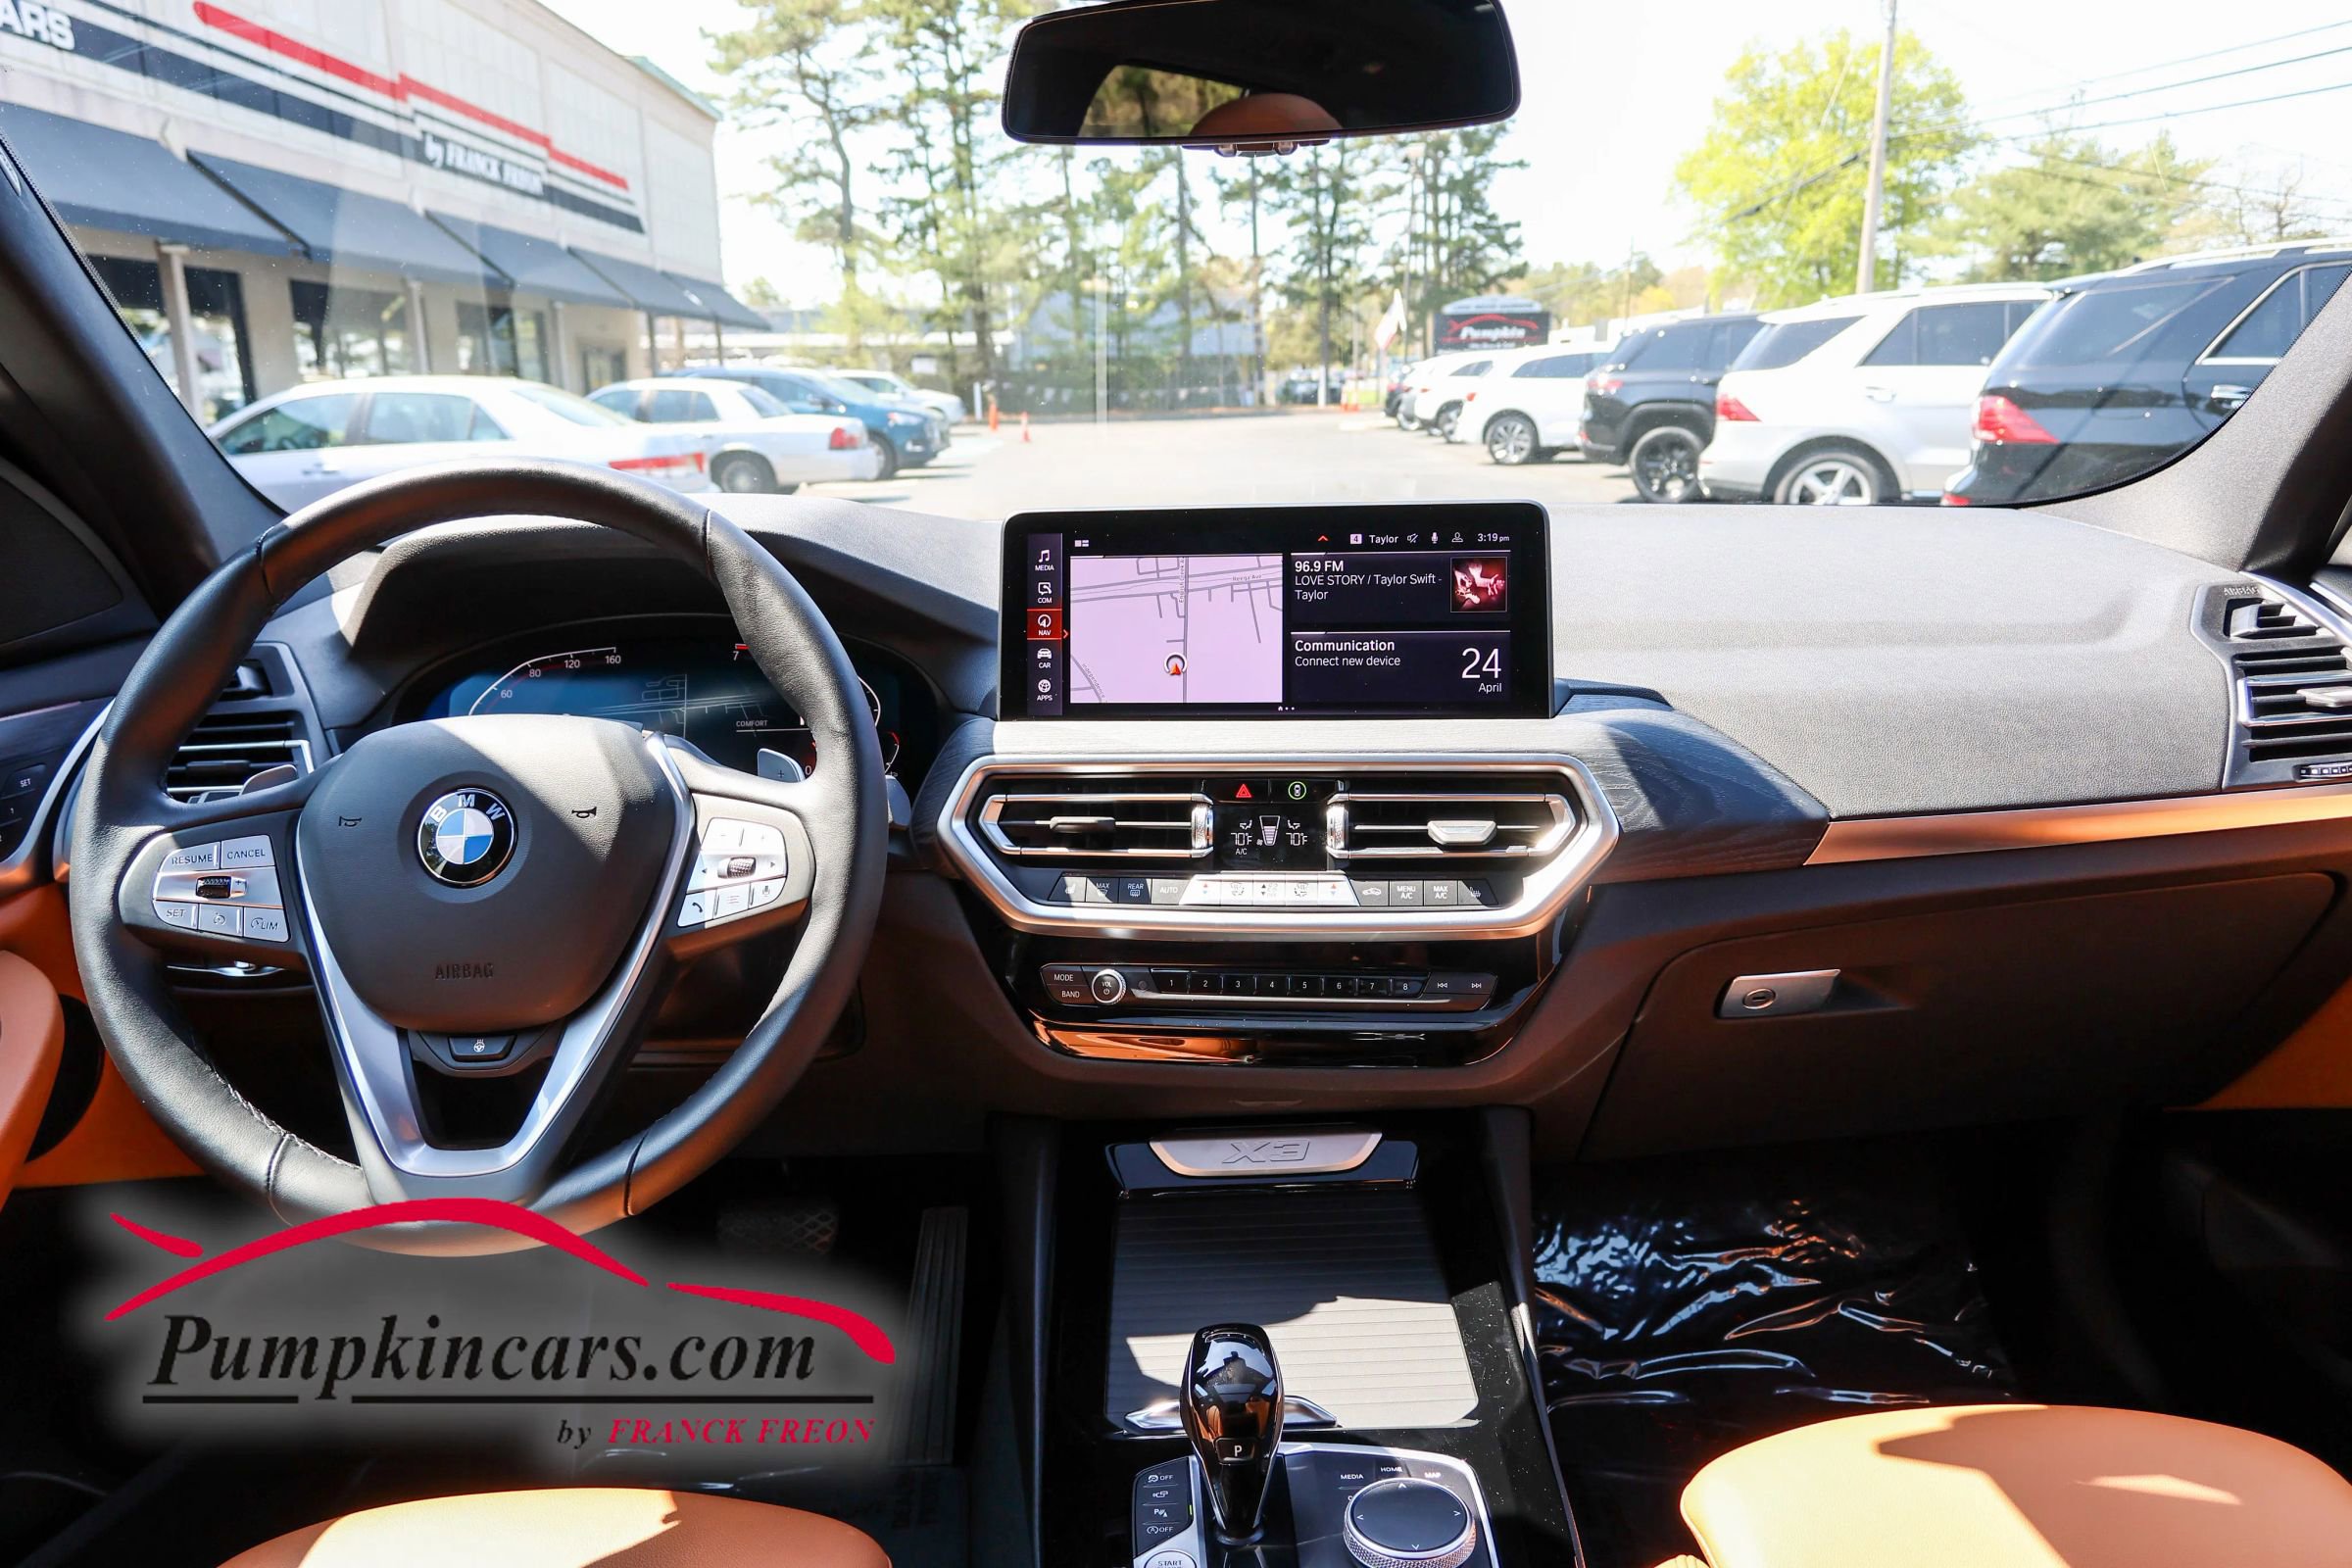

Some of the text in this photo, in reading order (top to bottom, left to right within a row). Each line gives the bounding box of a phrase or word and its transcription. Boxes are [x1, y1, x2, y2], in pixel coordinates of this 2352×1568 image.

[1369, 534, 1398, 544] Taylor
[1477, 533, 1498, 542] 3:19
[1295, 561, 1345, 572] 96.9 FM
[1295, 575, 1324, 586] LOVE
[1327, 574, 1365, 585] STORY
[1373, 574, 1407, 587] Taylor
[1409, 573, 1436, 584] Swift
[1295, 590, 1329, 602] Taylor
[1295, 640, 1395, 652] Communication
[606, 656, 621, 664] 160
[733, 651, 740, 661] 7
[1295, 656, 1401, 666] Connect new device
[564, 660, 580, 668] 120
[1461, 648, 1502, 679] 24
[529, 669, 541, 678] 80
[1478, 683, 1502, 694] April
[500, 690, 513, 699] 60
[20, 778, 31, 788] SET
[430, 794, 505, 823] BMW
[172, 854, 213, 865] RESUME
[226, 849, 266, 859] CANCEL
[167, 908, 185, 917] SET
[261, 921, 278, 930] LIM
[434, 963, 494, 979] AIRBAG
[1061, 990, 1081, 999] BAND
[1222, 1139, 1309, 1163] X3
[1234, 1445, 1243, 1457] P
